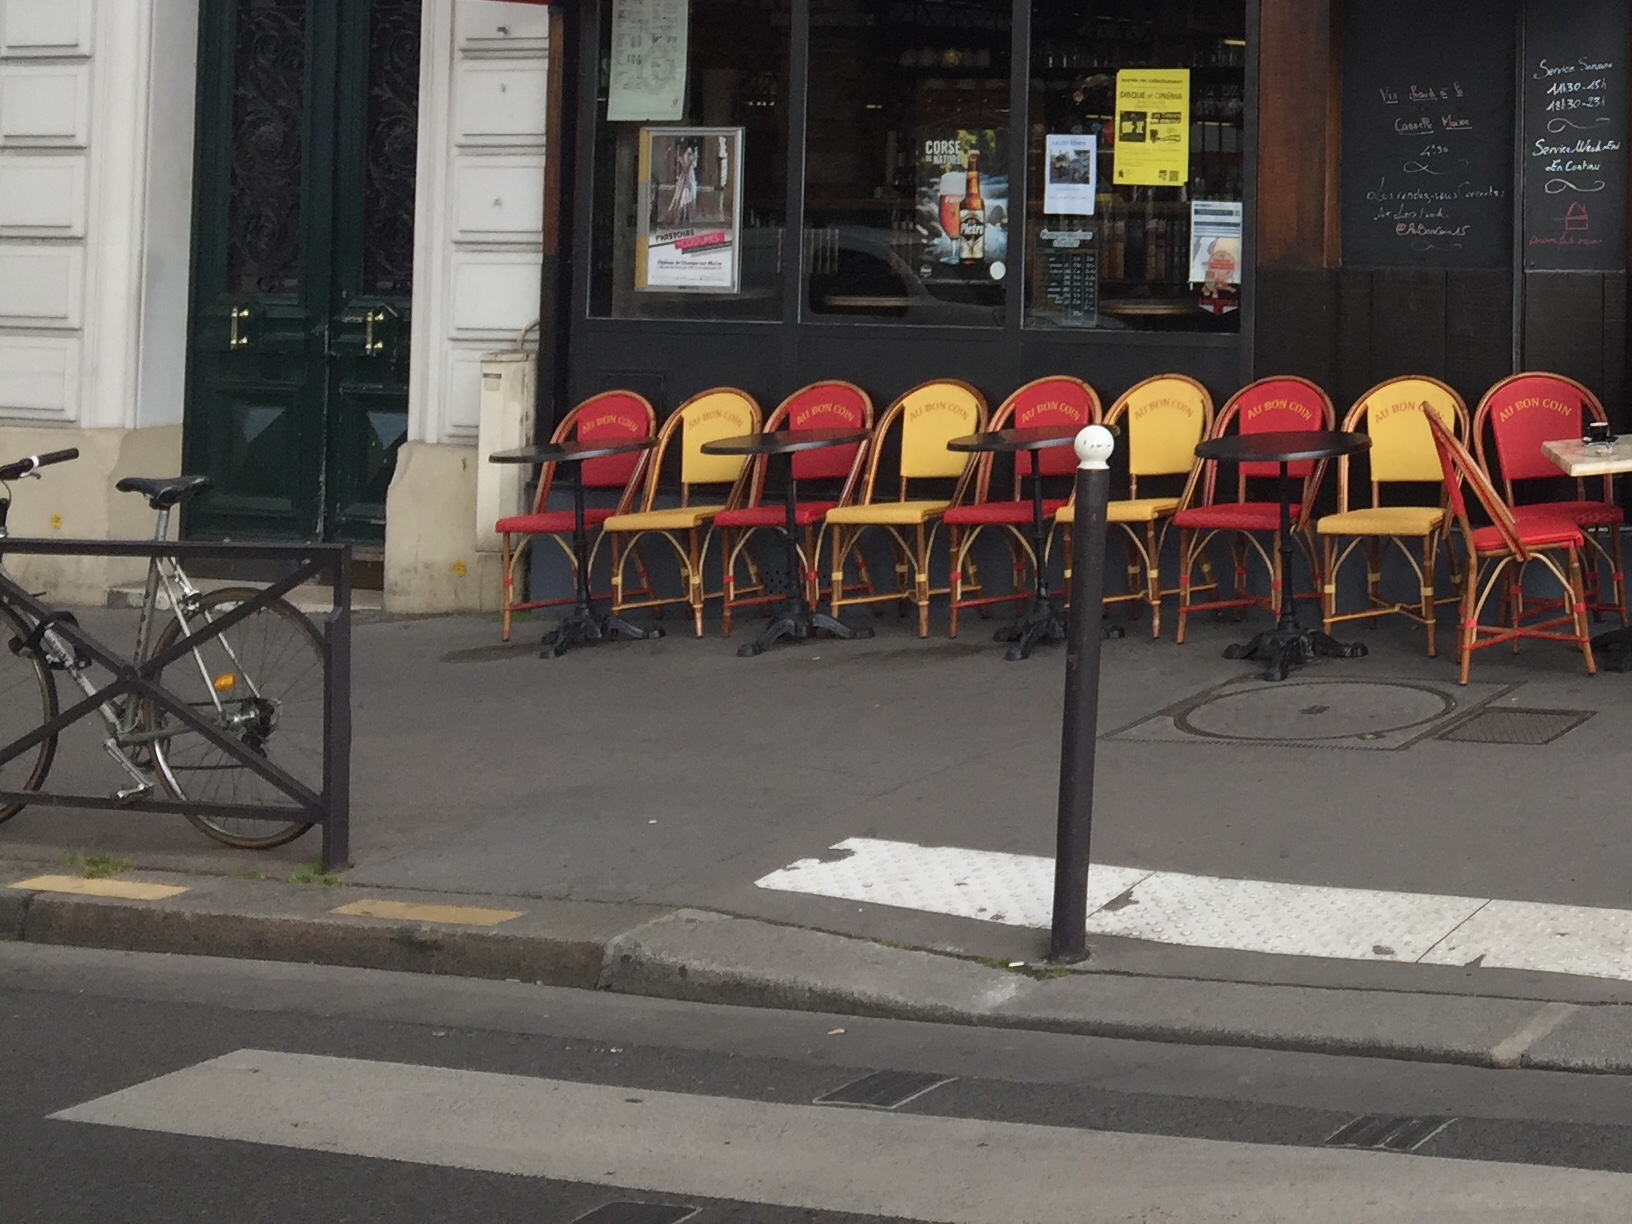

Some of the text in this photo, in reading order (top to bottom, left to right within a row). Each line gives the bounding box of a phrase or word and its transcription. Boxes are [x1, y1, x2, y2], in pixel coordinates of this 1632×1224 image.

[1533, 59, 1575, 80] Service
[925, 139, 961, 155] CORSE
[1532, 138, 1571, 157] Service
[909, 401, 970, 422] AU BON COIN
[1021, 401, 1082, 424] AU BON COIN
[1134, 398, 1194, 420] AU BON COIN
[1246, 398, 1313, 421] AU BON COIN
[1375, 408, 1389, 423] AU
[1391, 401, 1416, 414] BON
[1500, 397, 1572, 422] AU BON COIN
